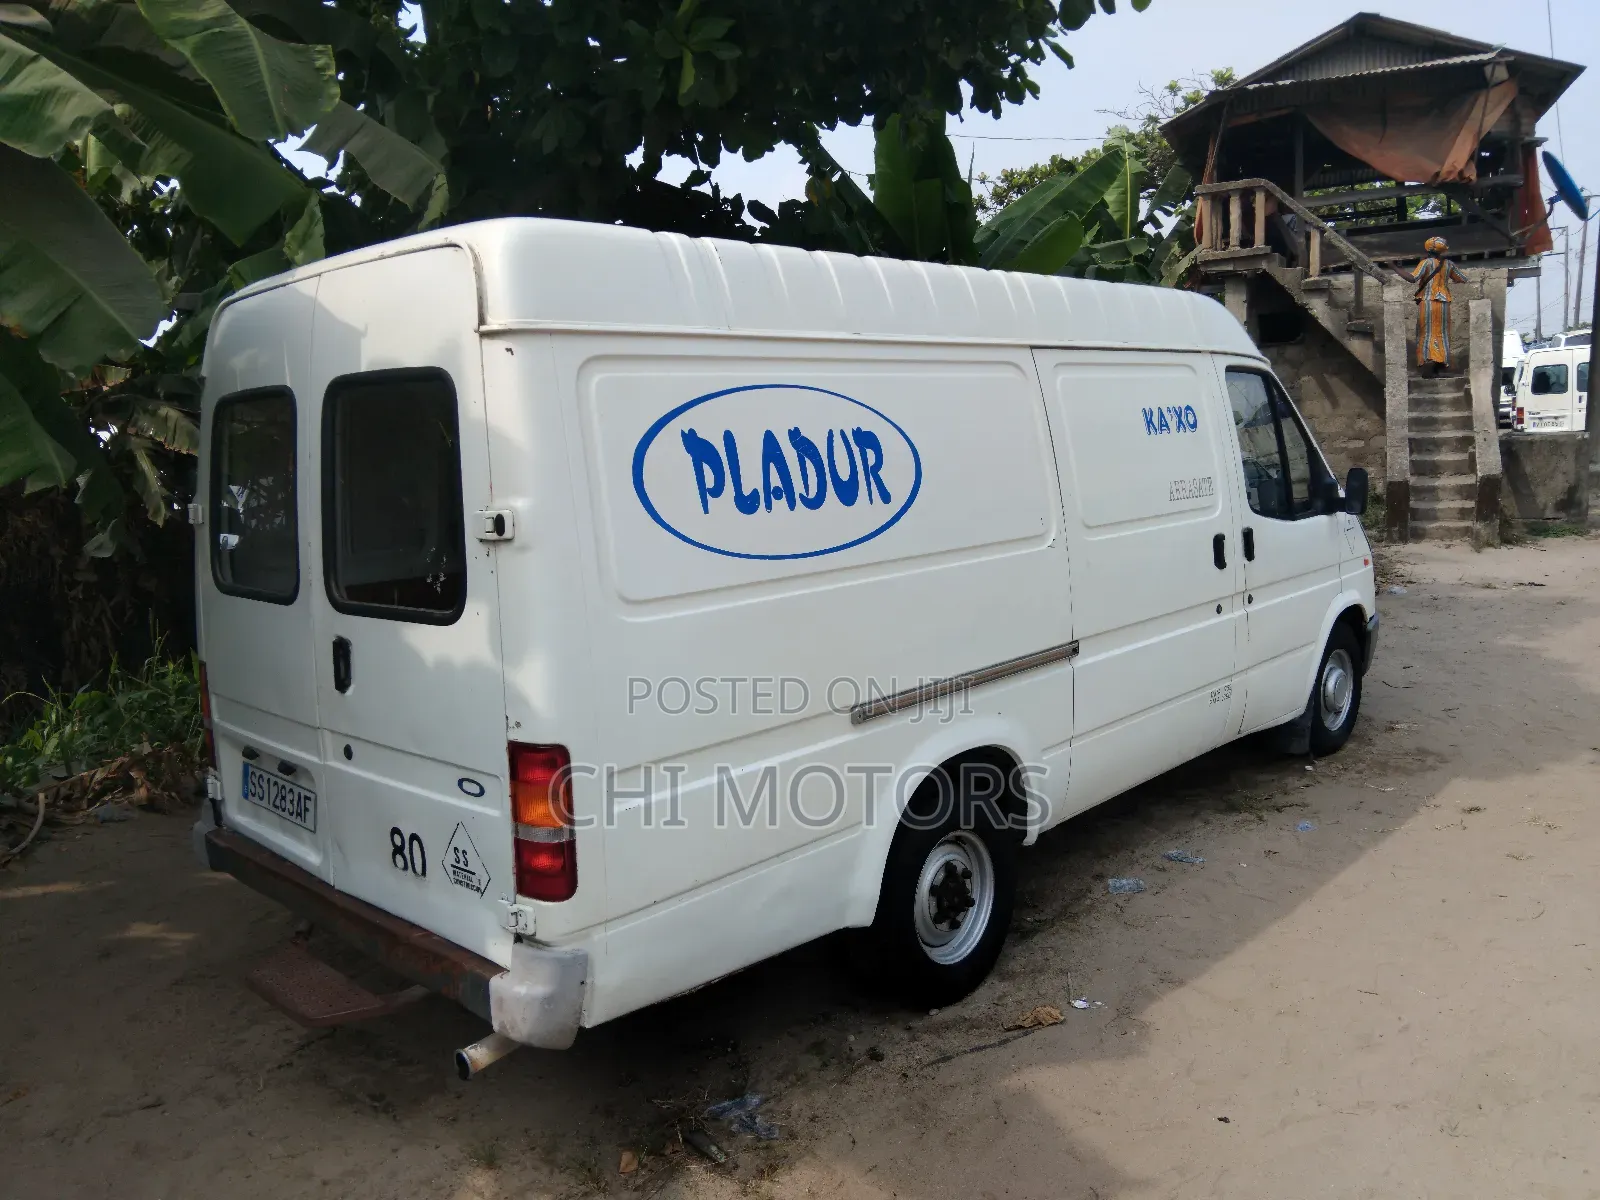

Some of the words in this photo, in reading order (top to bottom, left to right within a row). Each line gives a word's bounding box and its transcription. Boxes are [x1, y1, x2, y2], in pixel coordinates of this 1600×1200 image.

[680, 427, 891, 515] PLADUR
[250, 770, 311, 823] SS1283AF
[390, 826, 427, 877] 80
[454, 846, 469, 868] SS
